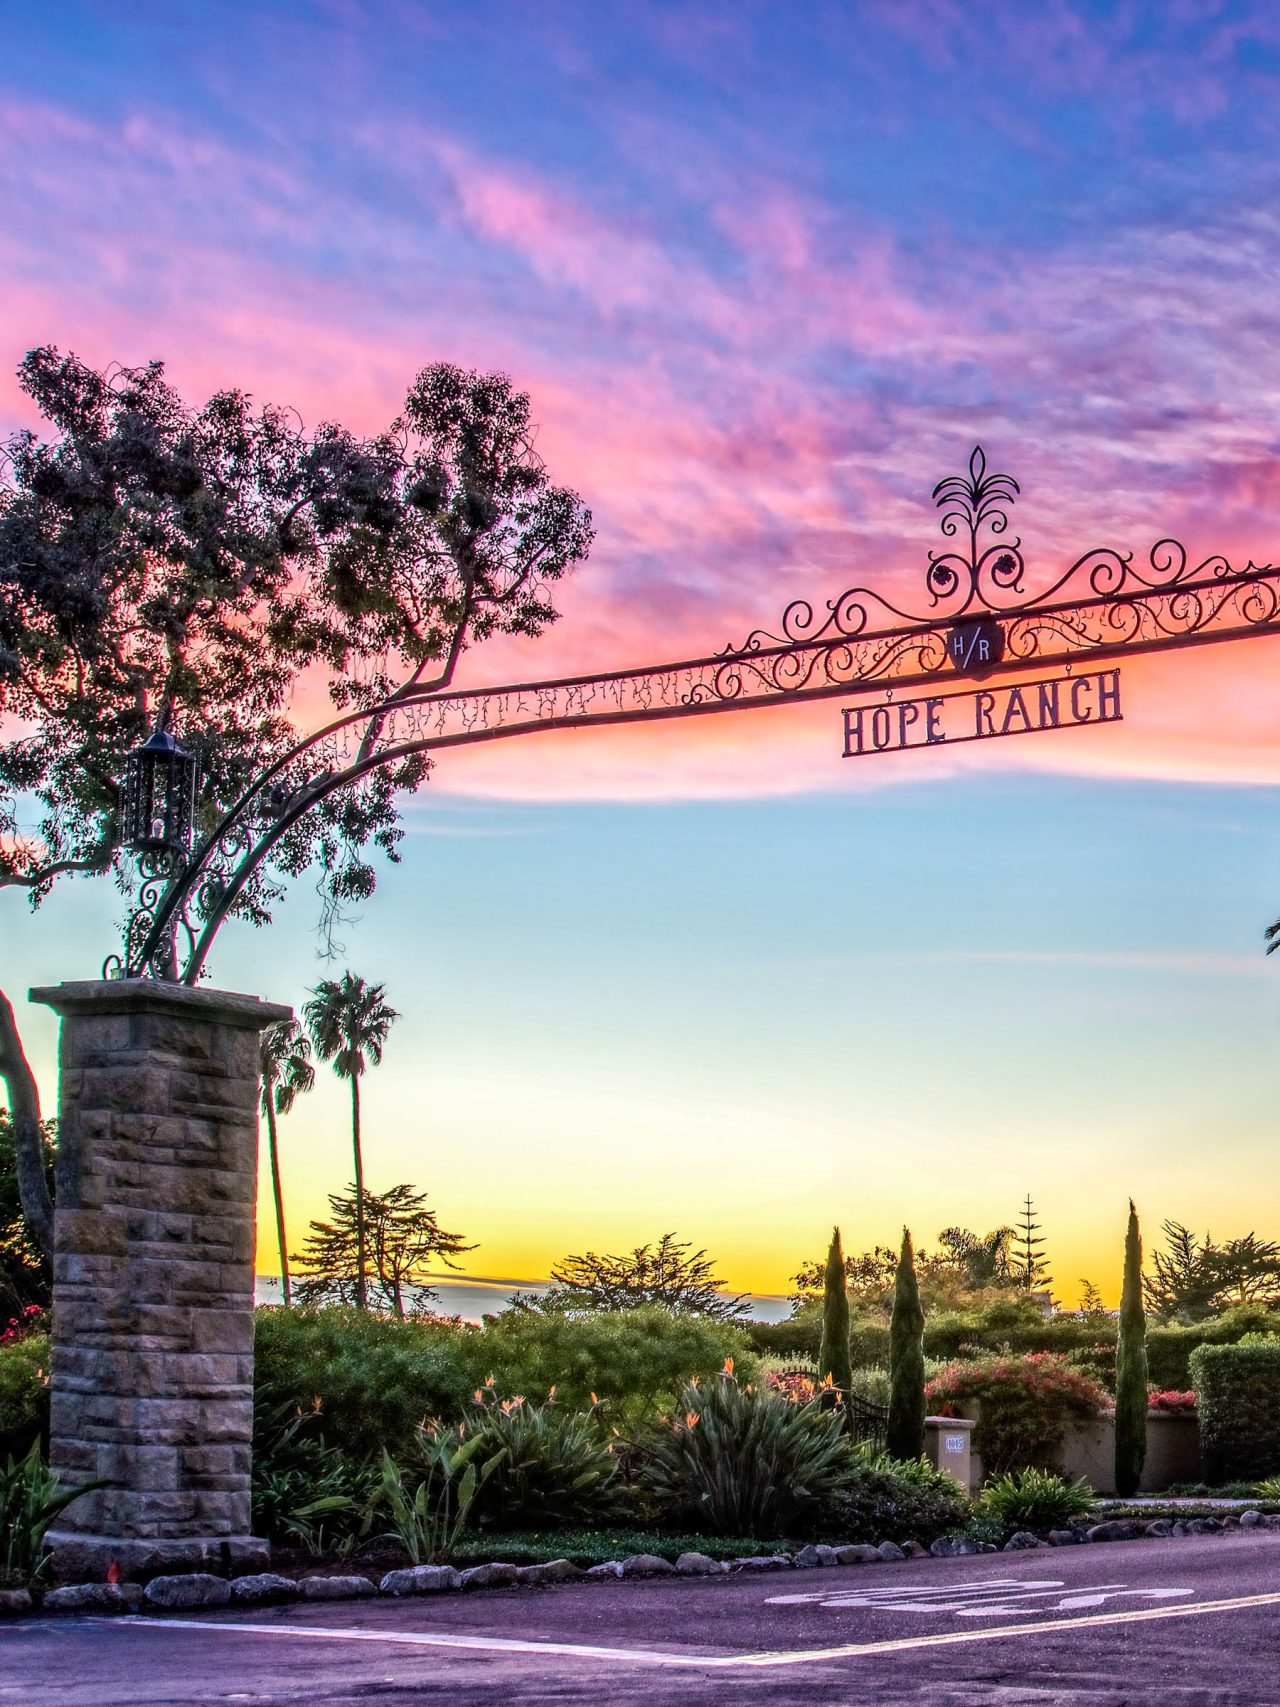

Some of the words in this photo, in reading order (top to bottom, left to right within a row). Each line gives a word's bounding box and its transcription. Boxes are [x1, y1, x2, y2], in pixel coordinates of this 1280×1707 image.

[843, 699, 946, 755] HOPE
[974, 670, 1123, 736] RANCH
[763, 1579, 1196, 1617] STOP
